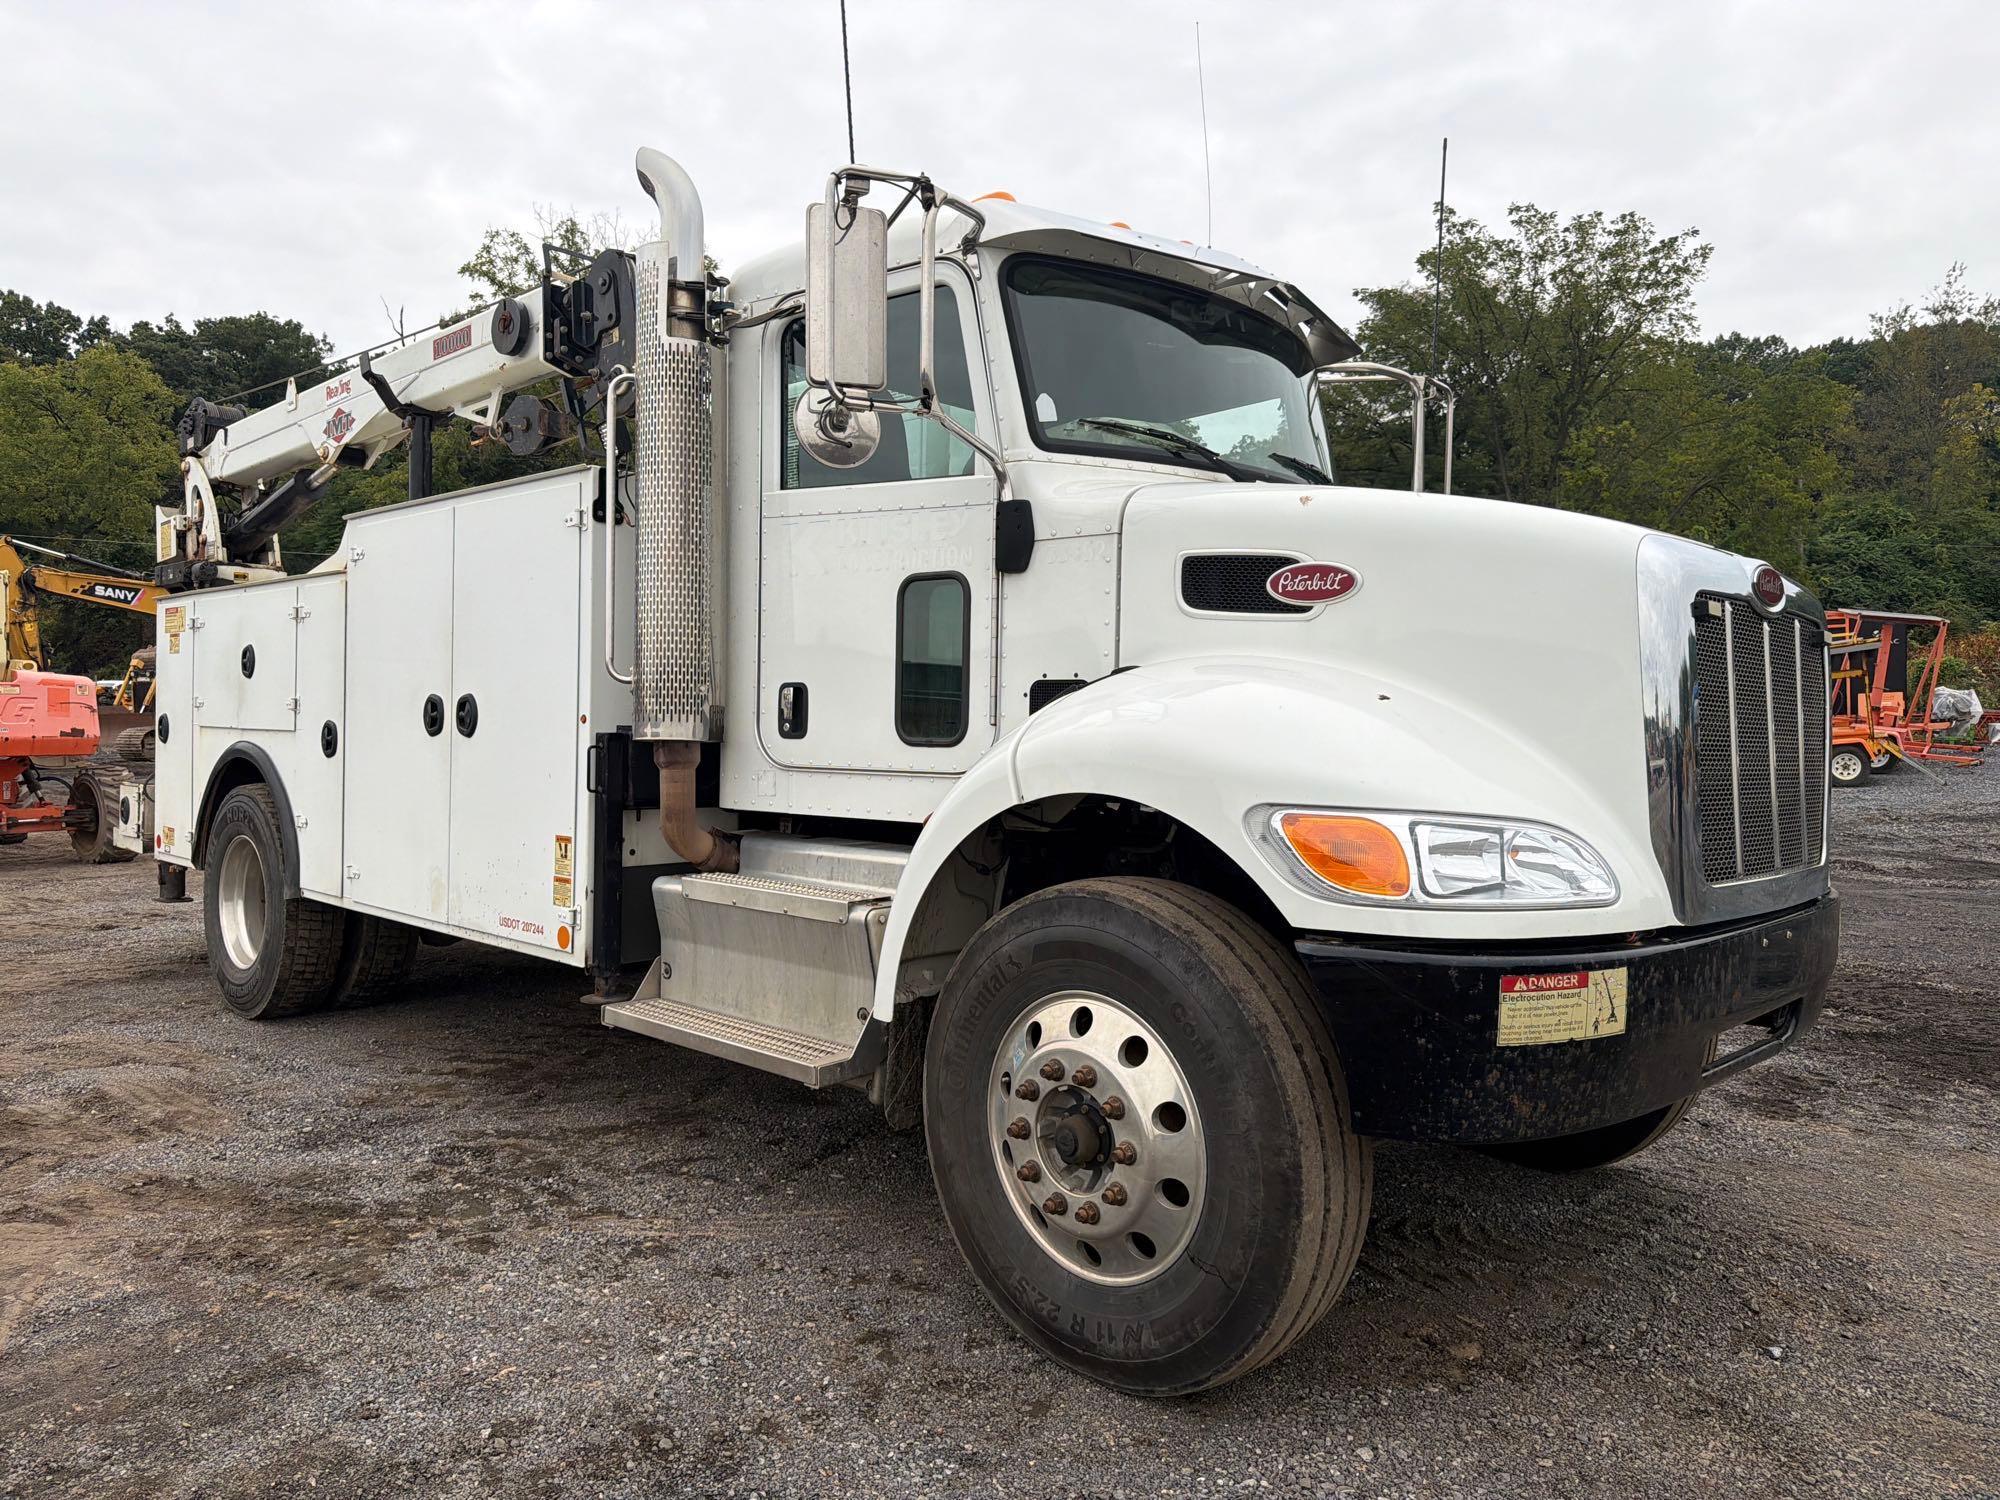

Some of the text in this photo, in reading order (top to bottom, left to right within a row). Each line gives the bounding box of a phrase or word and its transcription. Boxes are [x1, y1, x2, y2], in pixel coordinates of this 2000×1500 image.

[434, 327, 470, 359] 10000
[326, 410, 353, 439] IMT
[1278, 572, 1348, 593] Peterbilt
[94, 585, 136, 601] SANY
[499, 916, 544, 936] USDOT 207244
[1529, 975, 1578, 989] DANGER
[1502, 991, 1581, 1002] Electrocution Hazard
[1070, 1313, 1086, 1336] R
